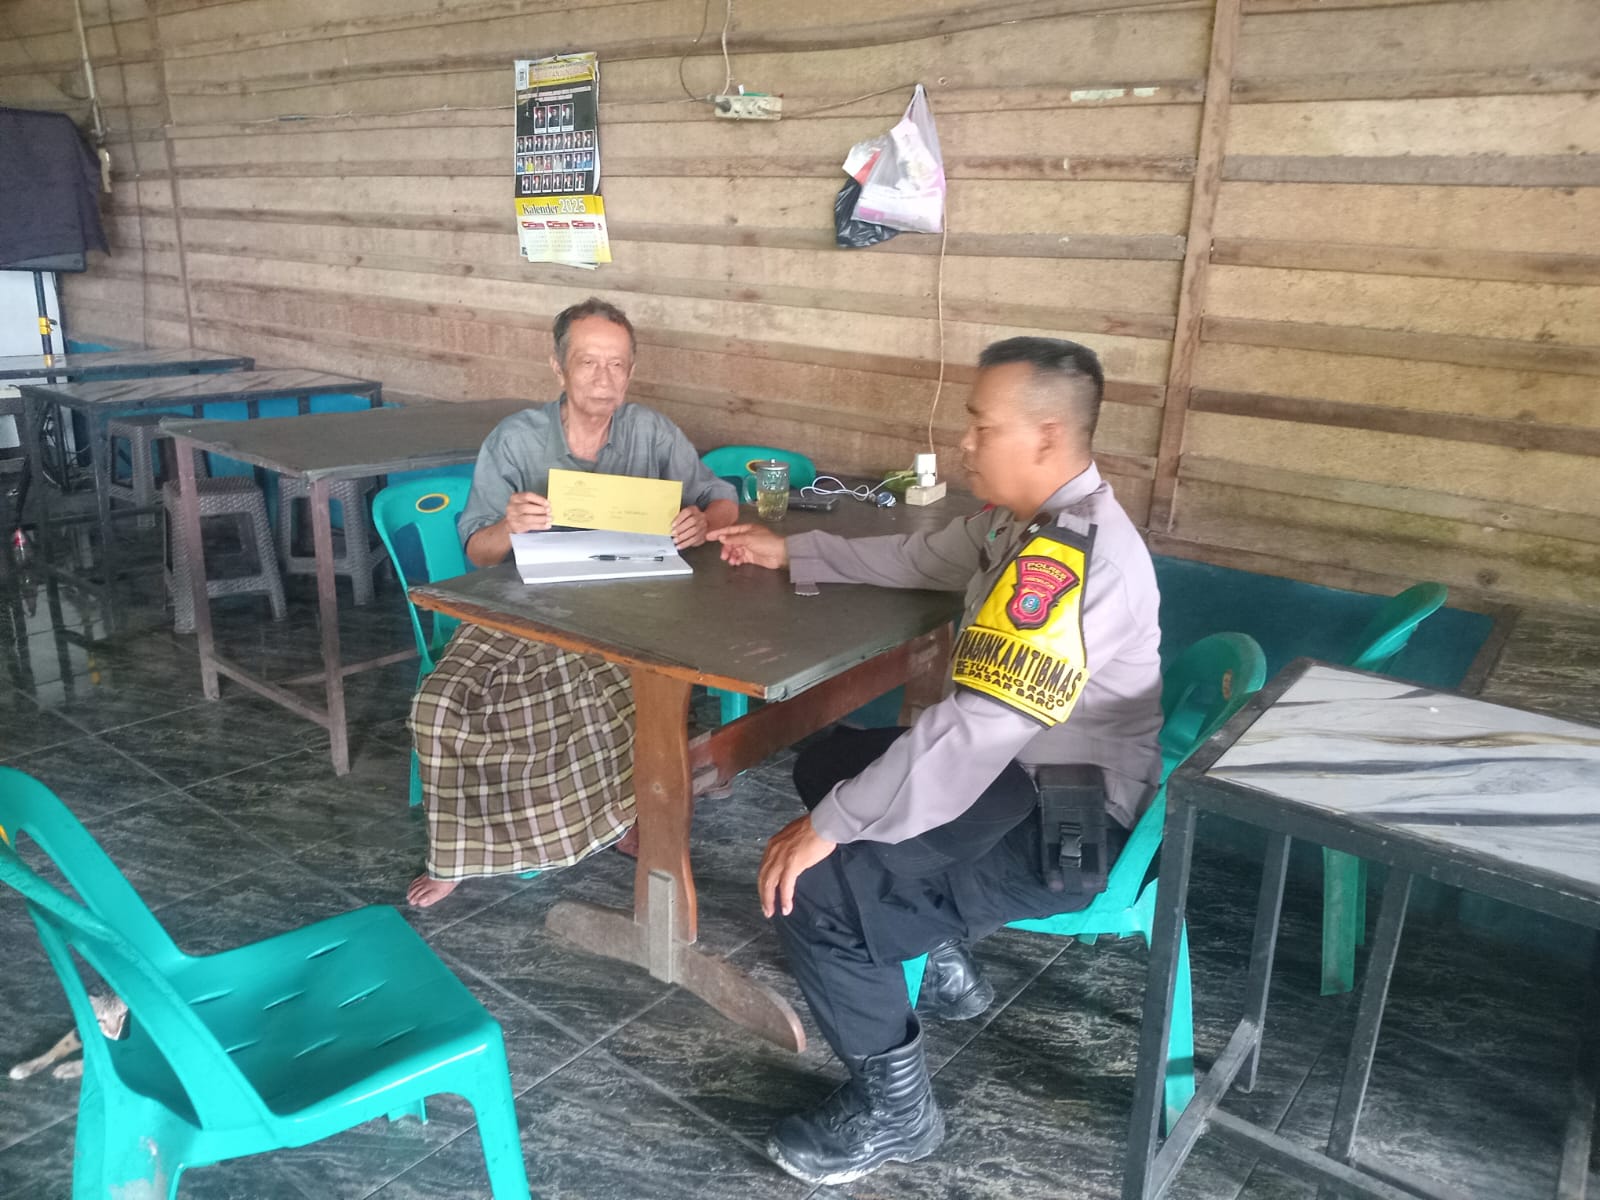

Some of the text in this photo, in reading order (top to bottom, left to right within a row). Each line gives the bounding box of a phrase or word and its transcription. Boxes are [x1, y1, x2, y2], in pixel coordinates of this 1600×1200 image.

[522, 198, 586, 215] Kalender 2025
[1016, 687, 1055, 710] BARU
[1027, 684, 1065, 708] RASO
